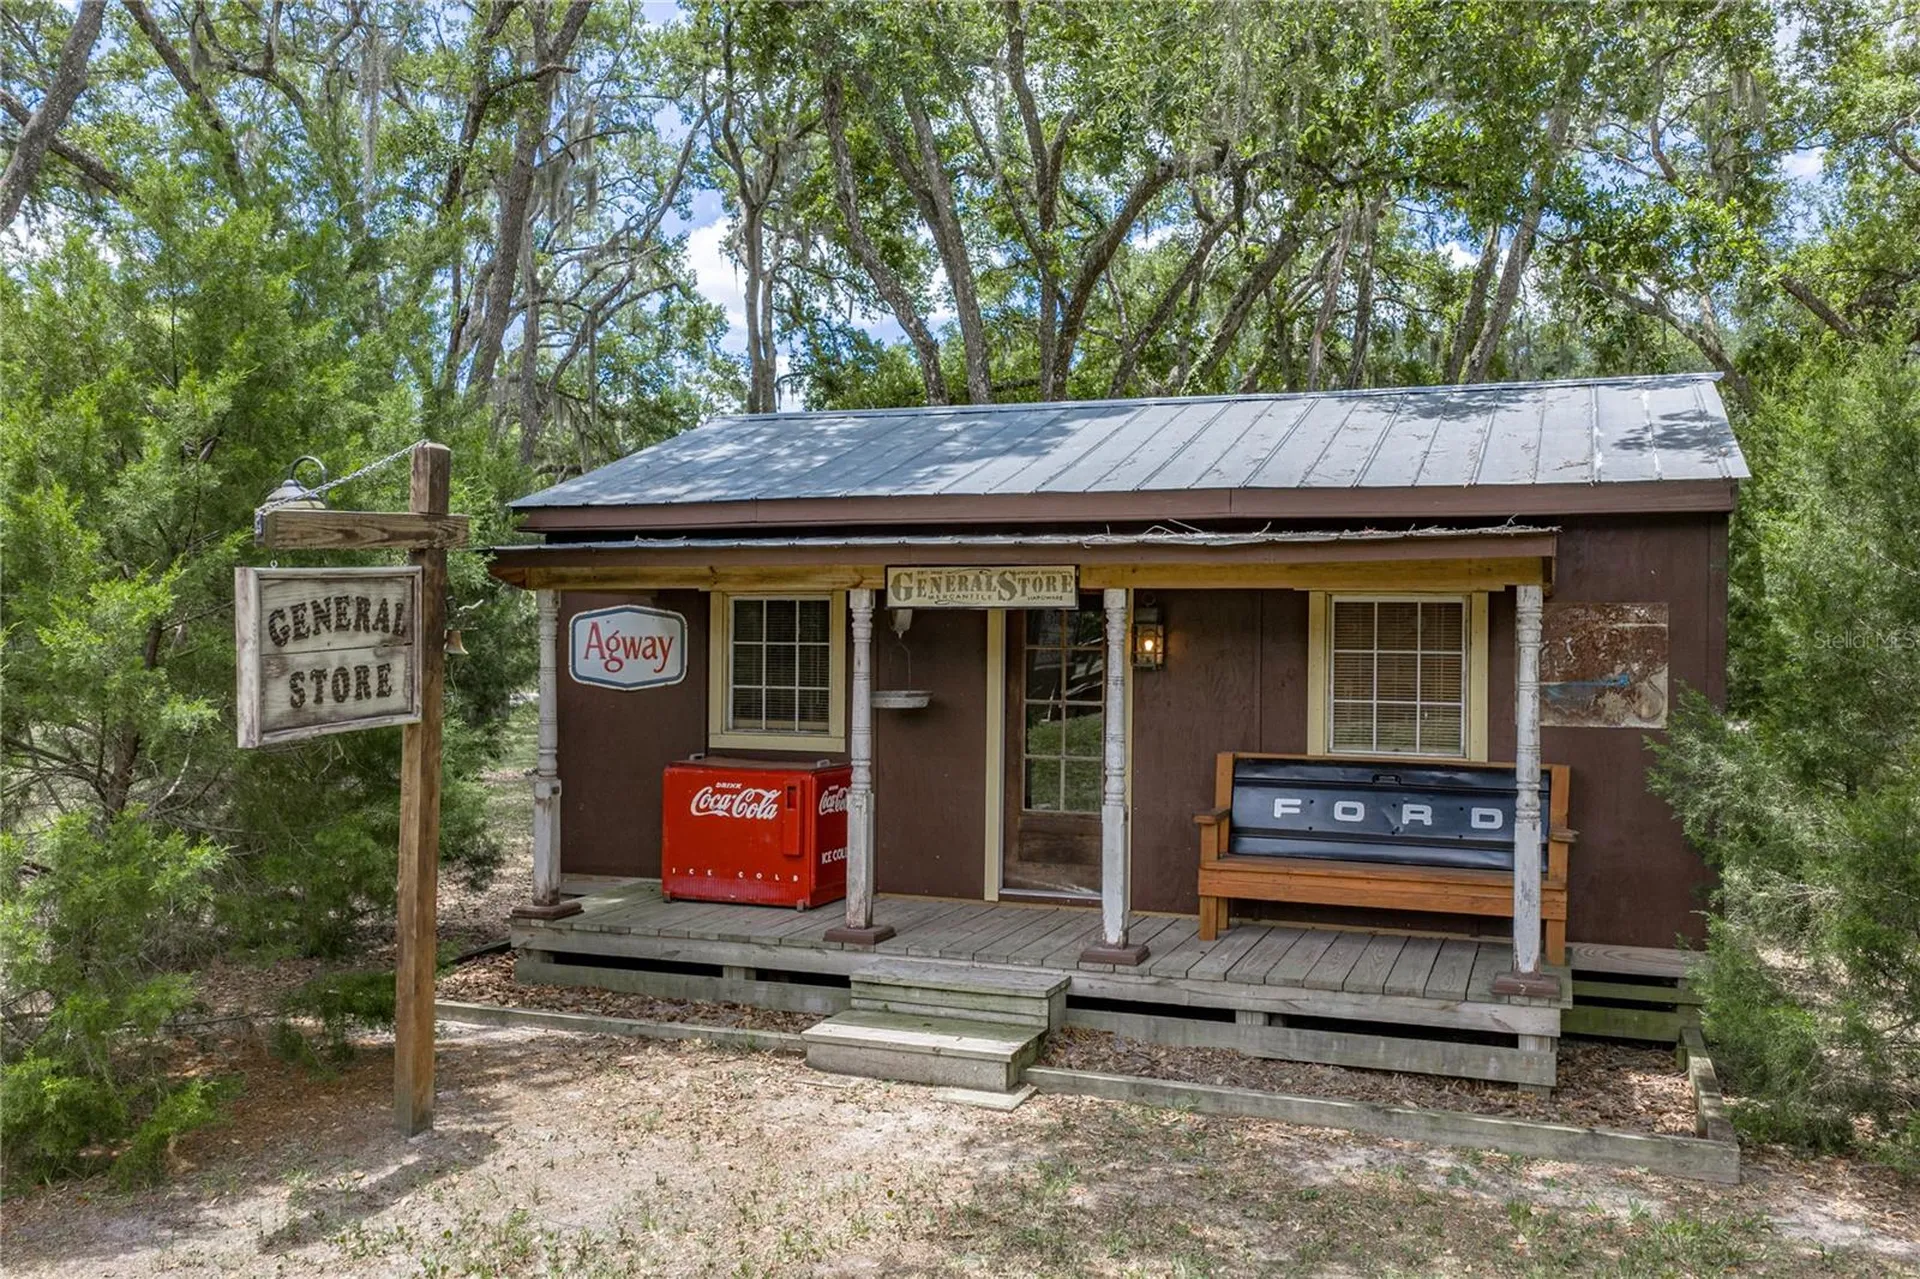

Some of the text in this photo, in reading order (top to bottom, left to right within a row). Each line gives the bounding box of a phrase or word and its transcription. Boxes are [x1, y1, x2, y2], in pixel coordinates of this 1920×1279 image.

[891, 570, 1074, 602] GENERAL STORE
[267, 595, 407, 648] GENERAL
[583, 621, 675, 674] Agway
[289, 663, 393, 709] STORE
[690, 786, 782, 820] Coca-Cola
[1273, 798, 1503, 830] FORD
[832, 847, 848, 861] COL
[672, 868, 799, 882] ICE COLD
